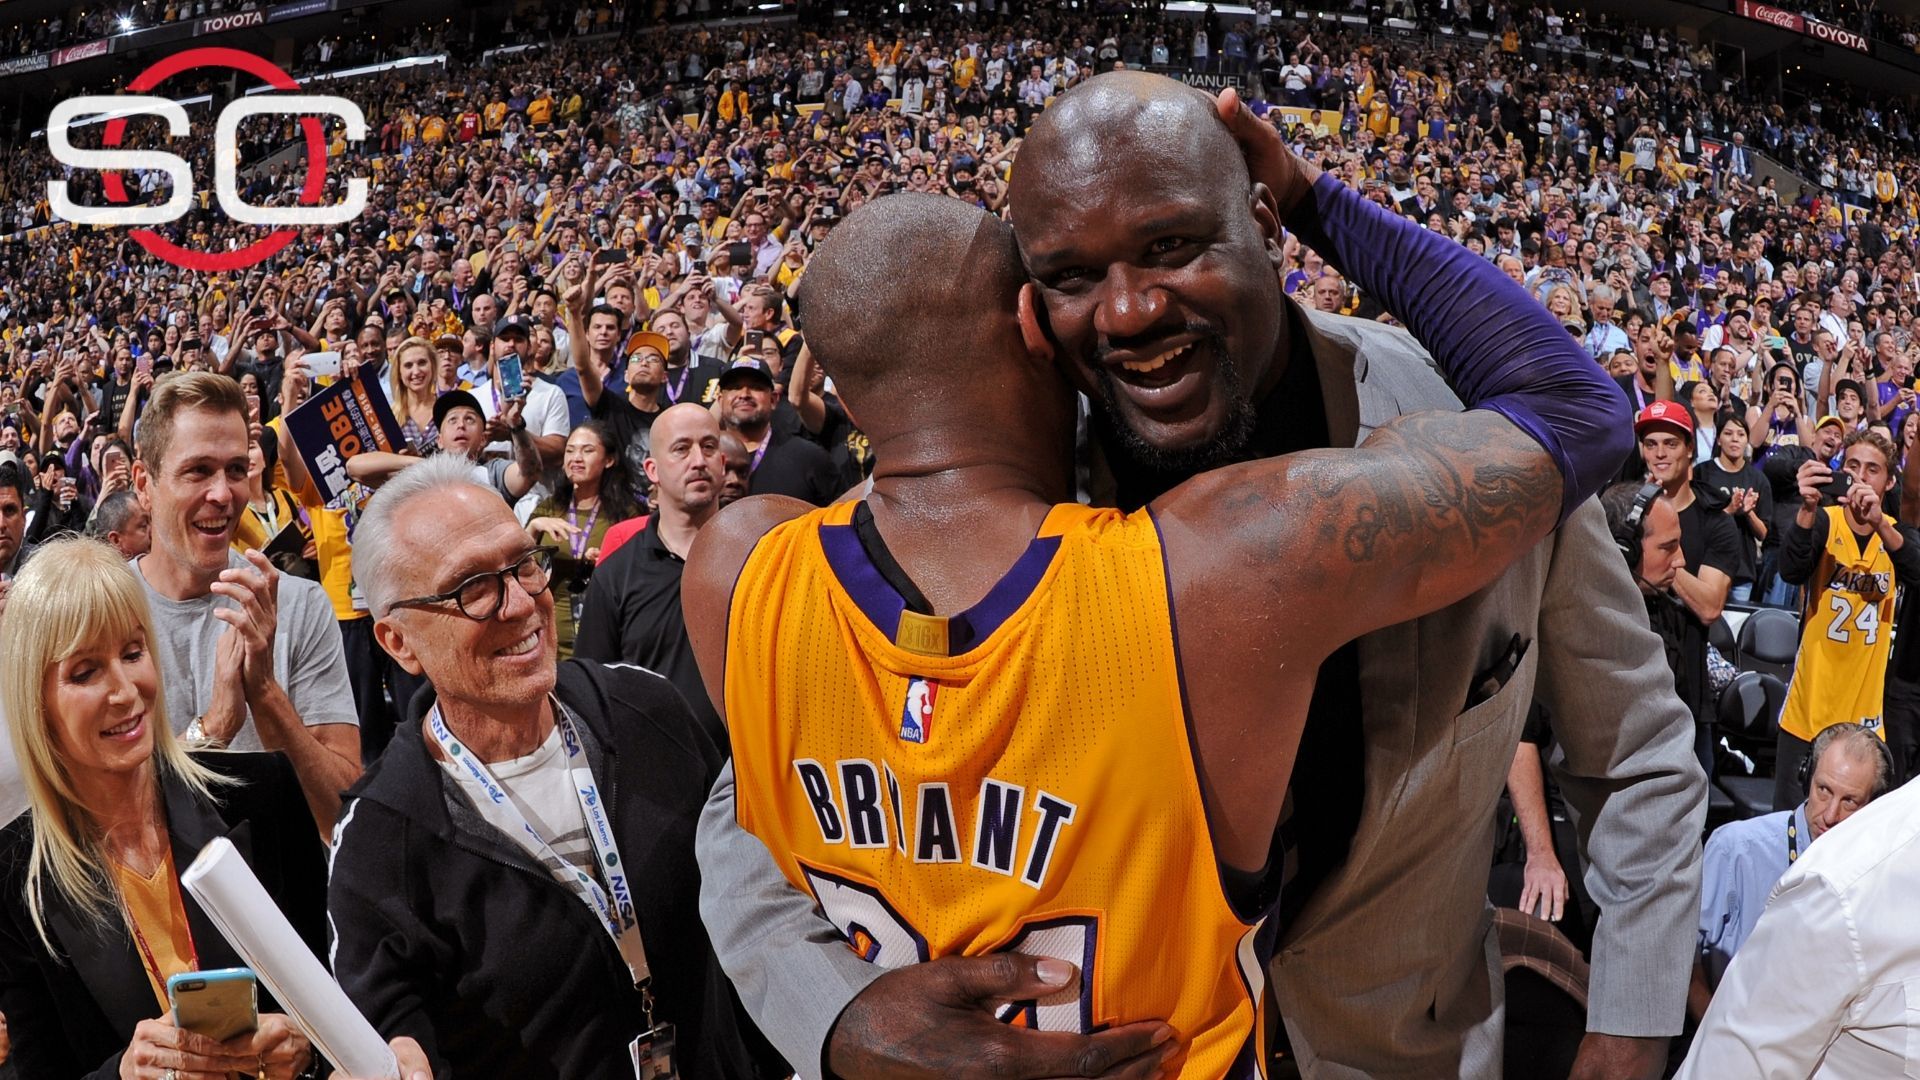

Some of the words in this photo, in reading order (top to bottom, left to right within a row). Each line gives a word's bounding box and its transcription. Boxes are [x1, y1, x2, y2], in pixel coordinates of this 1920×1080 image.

[203, 11, 263, 32] TOYOTA
[1806, 21, 1868, 51] TOYOTA
[15, 54, 48, 68] MANUEL
[1182, 73, 1245, 89] MANUEL
[320, 395, 361, 459] OBE
[1825, 563, 1891, 595] LAKERS
[1826, 594, 1879, 646] 24
[900, 727, 920, 740] NBA
[592, 806, 600, 820] Los
[597, 820, 610, 847] Alamos
[611, 876, 635, 931] NNSA
